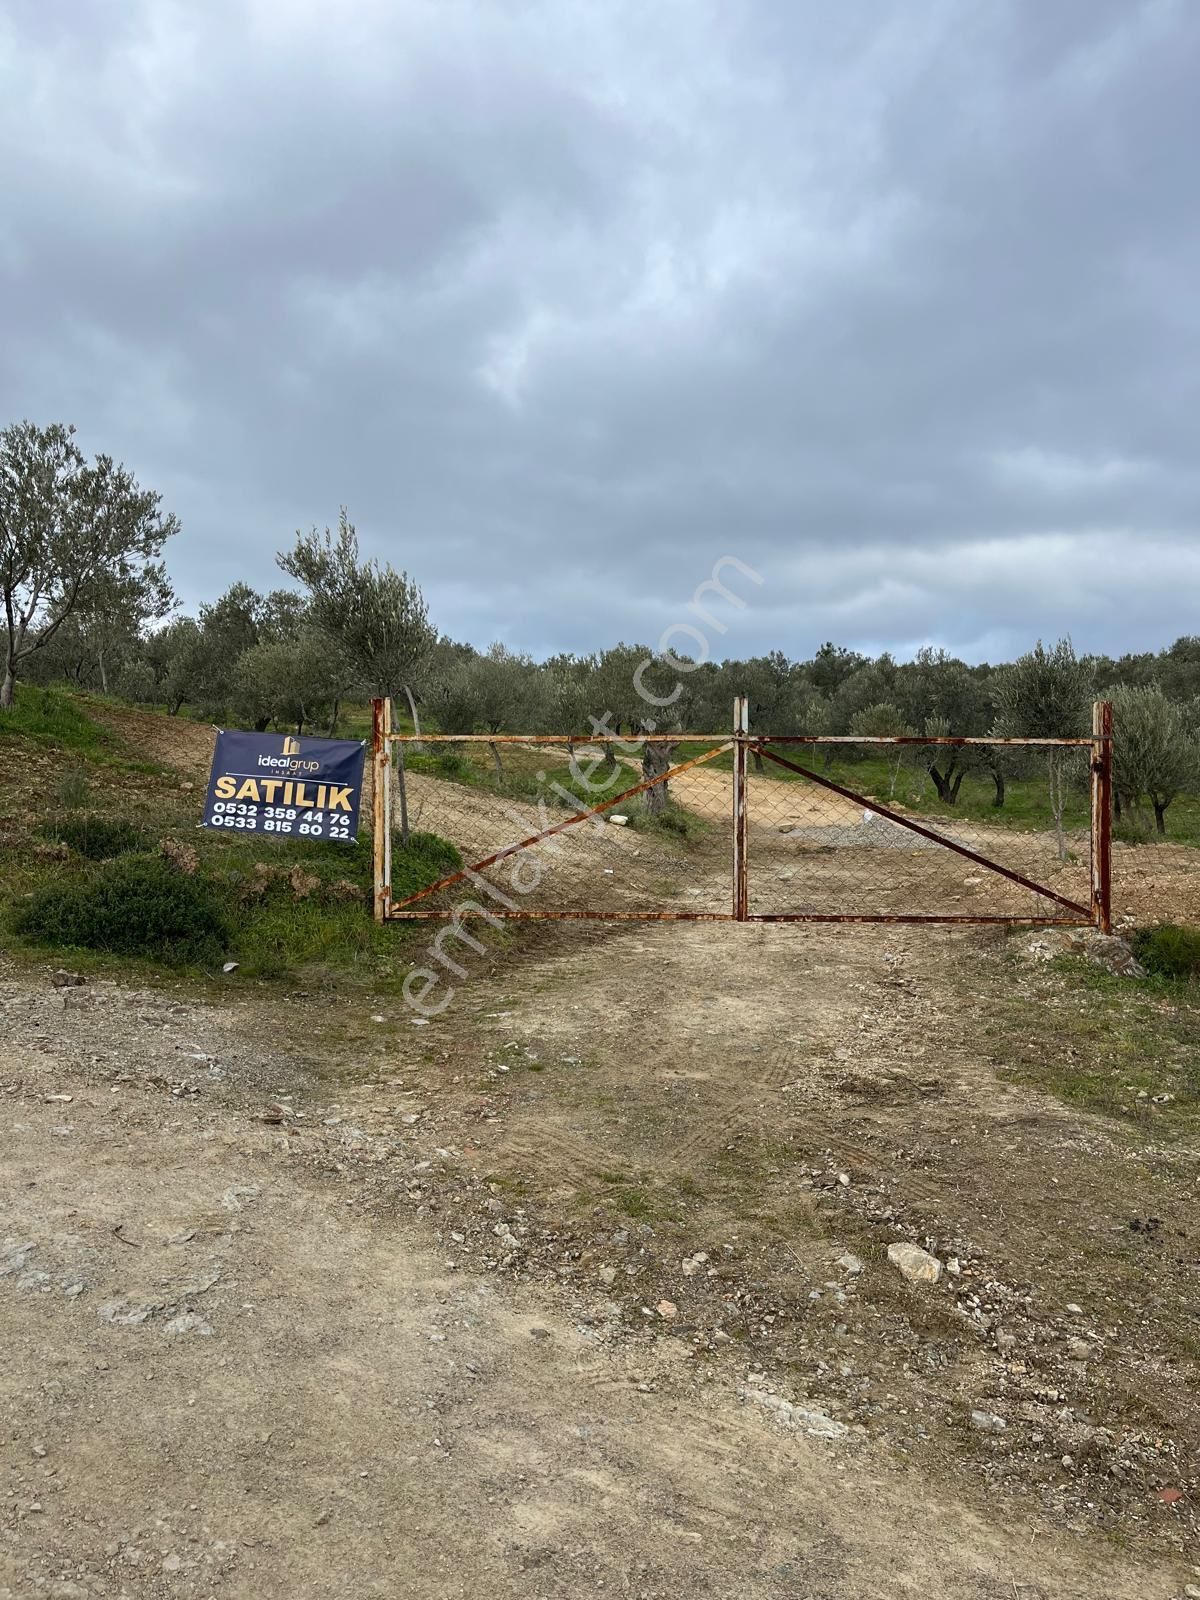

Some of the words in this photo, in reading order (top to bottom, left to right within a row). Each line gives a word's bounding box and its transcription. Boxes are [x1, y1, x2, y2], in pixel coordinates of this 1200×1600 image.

[258, 755, 319, 772] idealgrup
[214, 776, 354, 812] SATILIK
[213, 802, 258, 816] 0532
[264, 807, 296, 820] 358
[303, 811, 323, 823] 44
[329, 813, 350, 826] 76
[211, 815, 257, 829] 0533
[264, 820, 292, 832] 815
[299, 823, 323, 835] 80
[329, 827, 349, 838] 22
